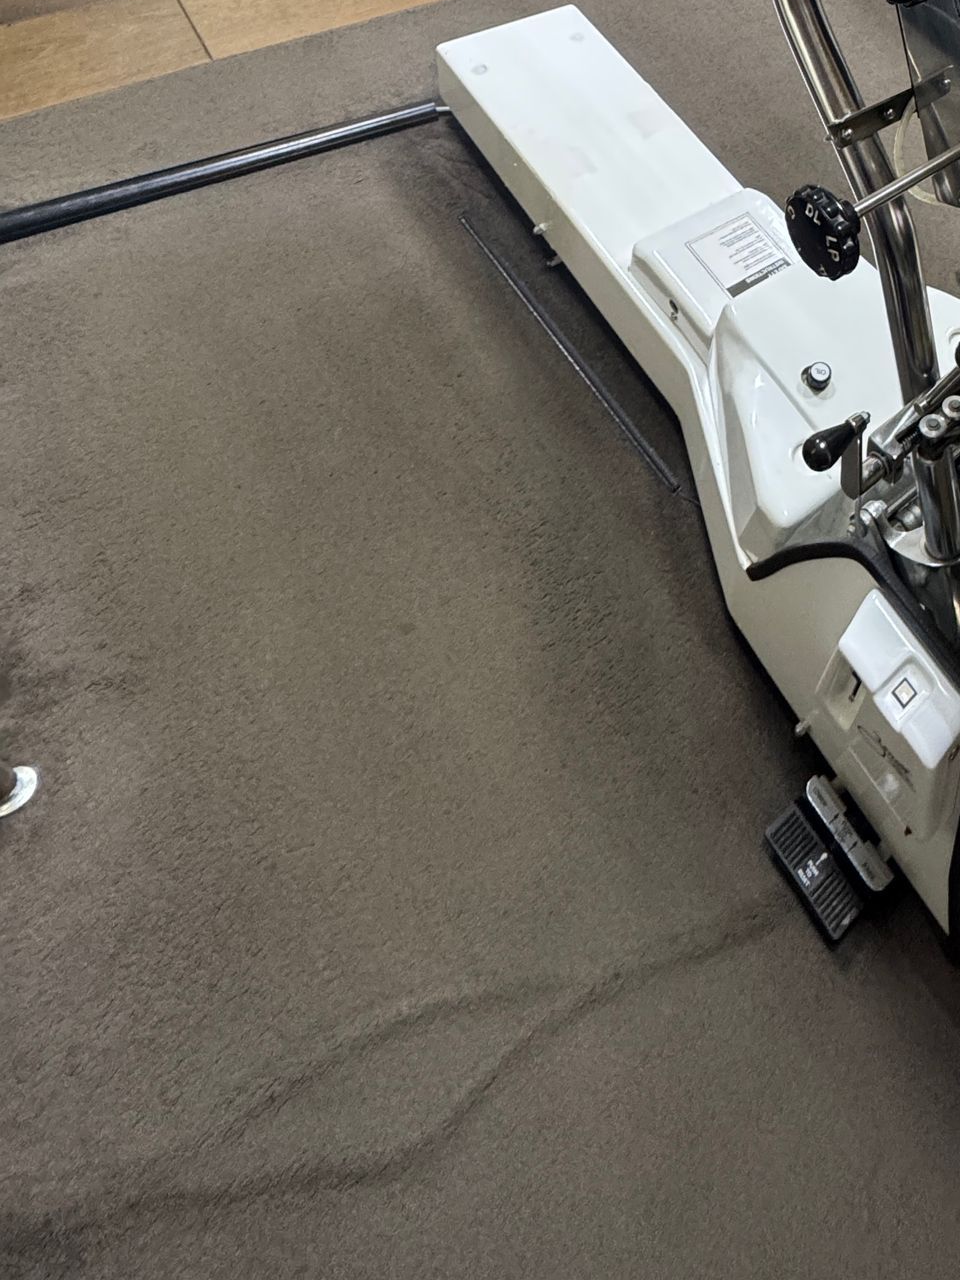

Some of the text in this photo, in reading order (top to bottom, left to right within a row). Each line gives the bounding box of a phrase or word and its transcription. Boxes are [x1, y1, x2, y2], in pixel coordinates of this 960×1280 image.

[805, 203, 821, 226] DL
[825, 235, 840, 262] LP
[815, 368, 827, 376] OIL
